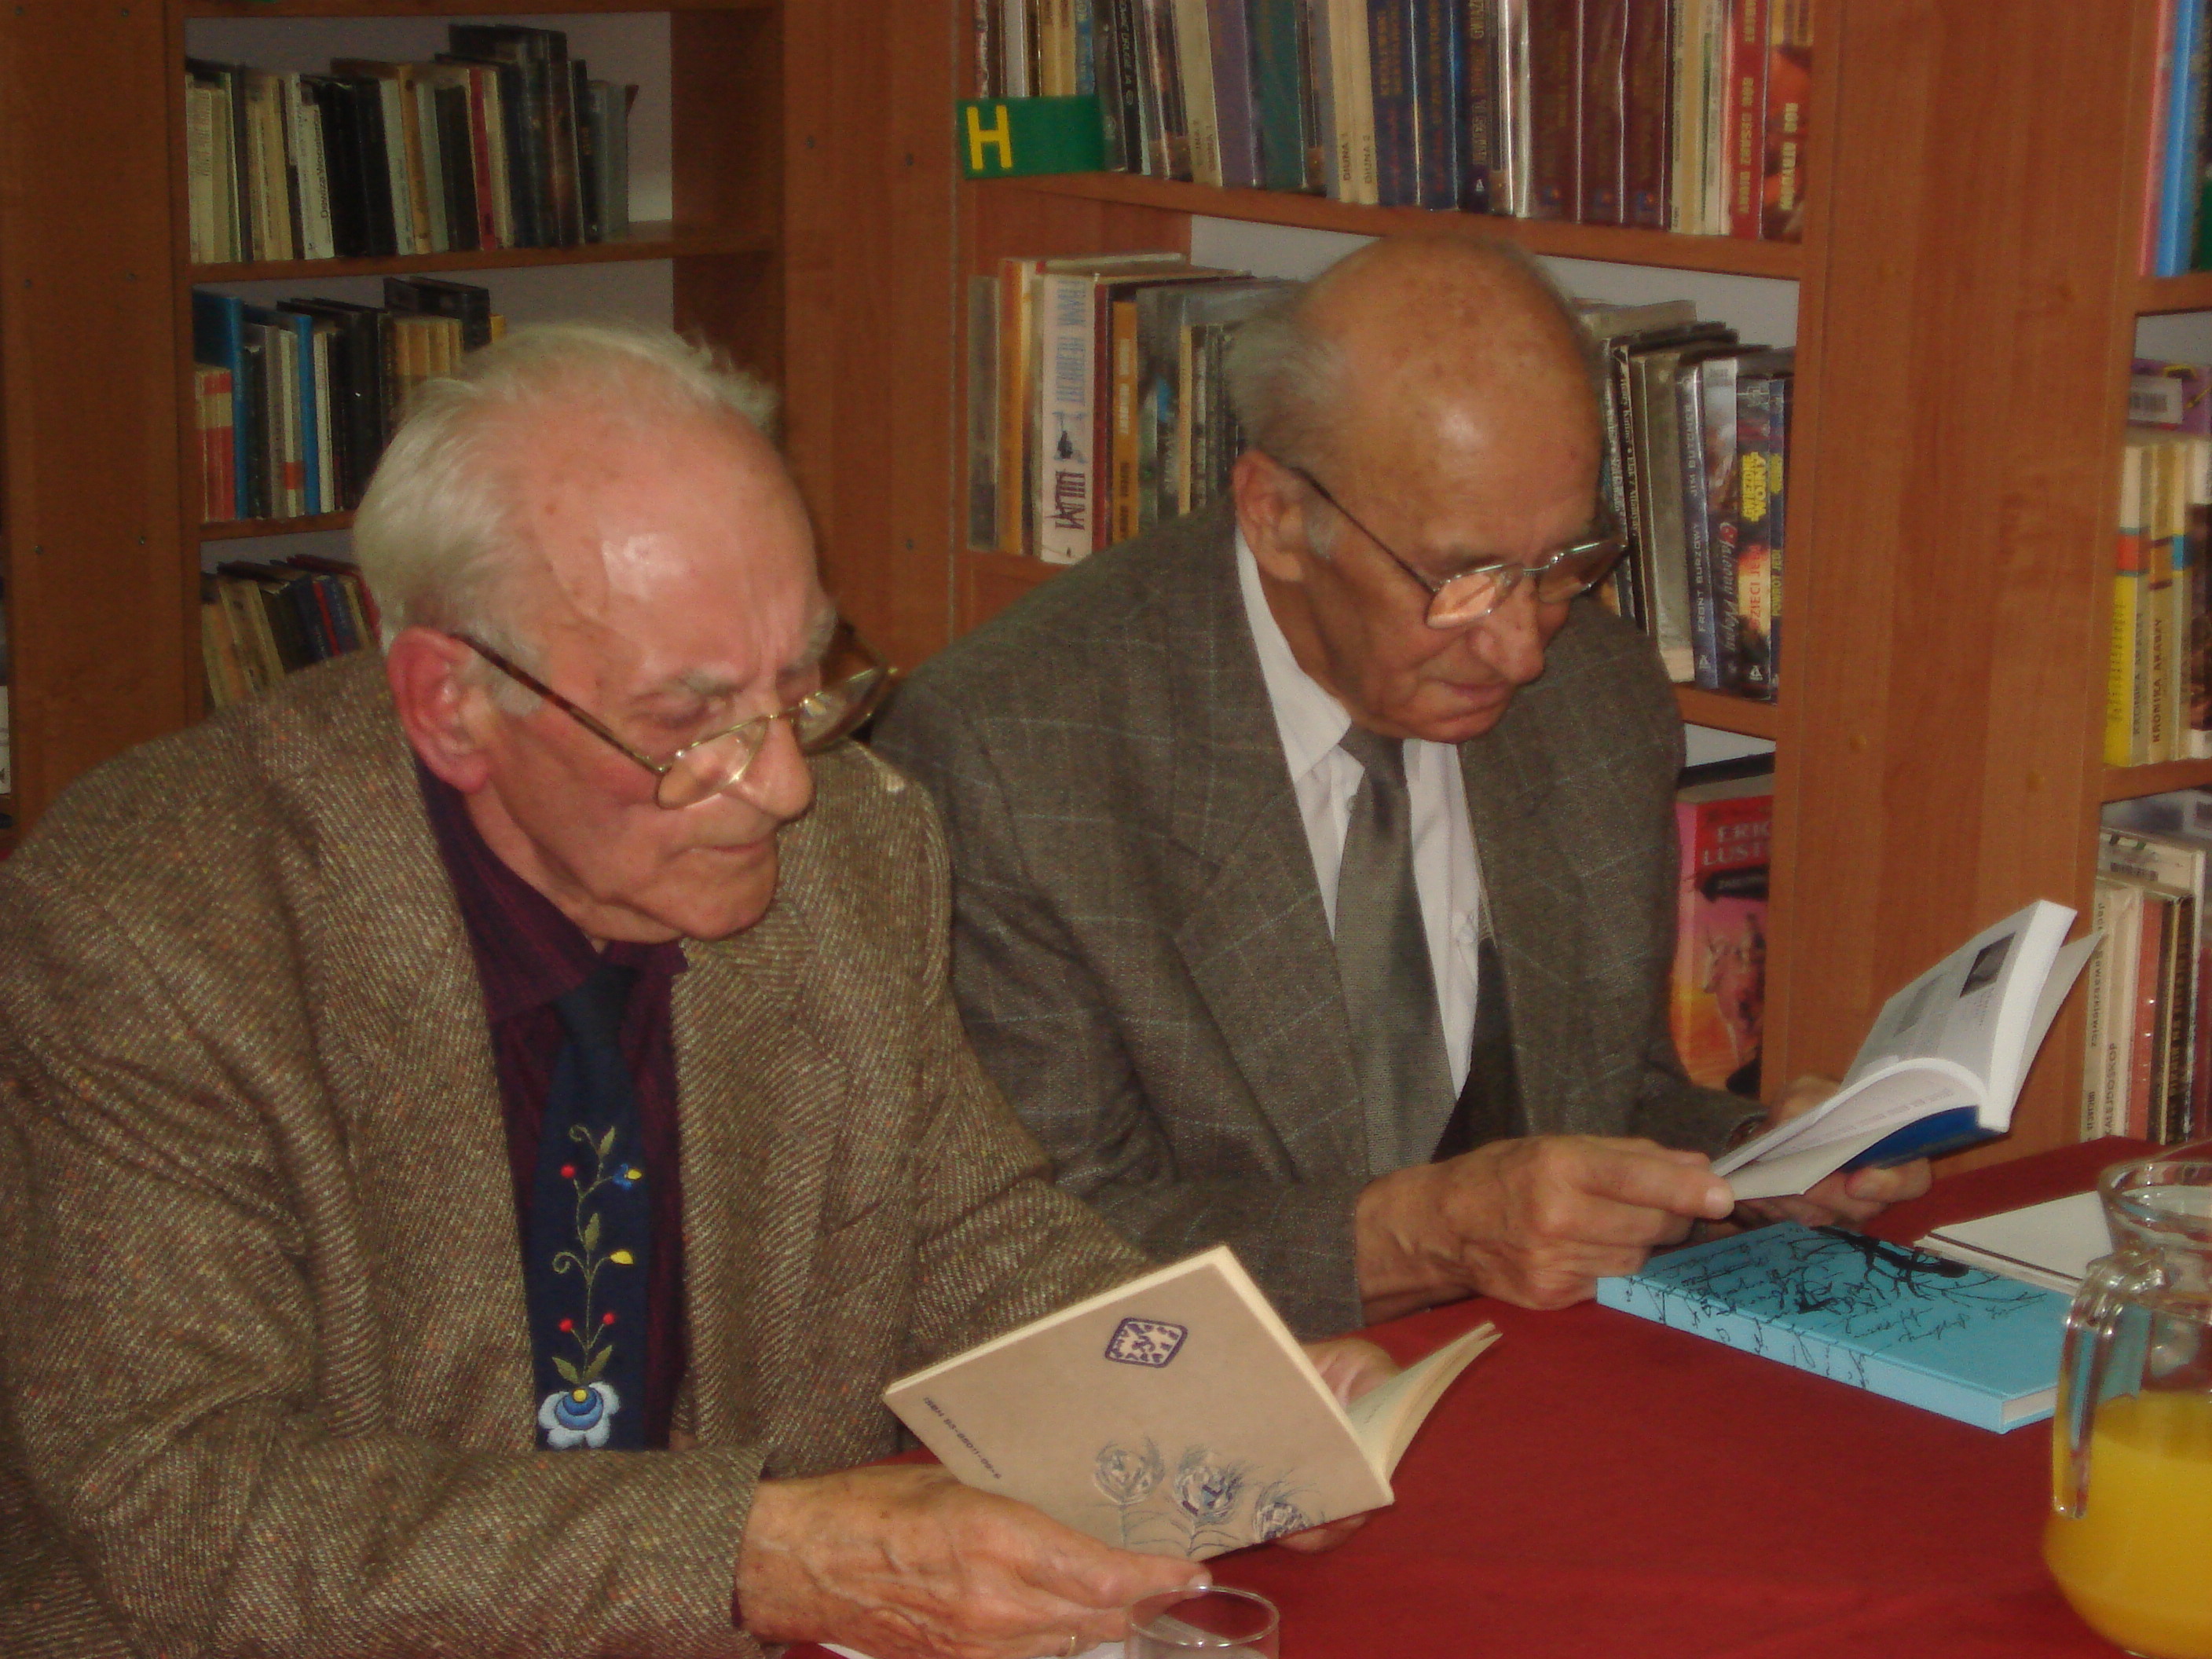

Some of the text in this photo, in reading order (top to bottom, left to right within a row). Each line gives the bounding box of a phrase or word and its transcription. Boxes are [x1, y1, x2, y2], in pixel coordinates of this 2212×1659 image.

[966, 104, 1013, 170] H
[1685, 403, 1698, 496] JIM BUTCHER
[1755, 456, 1767, 515] WOJNY
[1692, 522, 1706, 633] FRONT BURZOWY
[2152, 679, 2162, 743] KRONIKA
[1702, 842, 1761, 866] LUST
[2096, 903, 2106, 933] Jace
